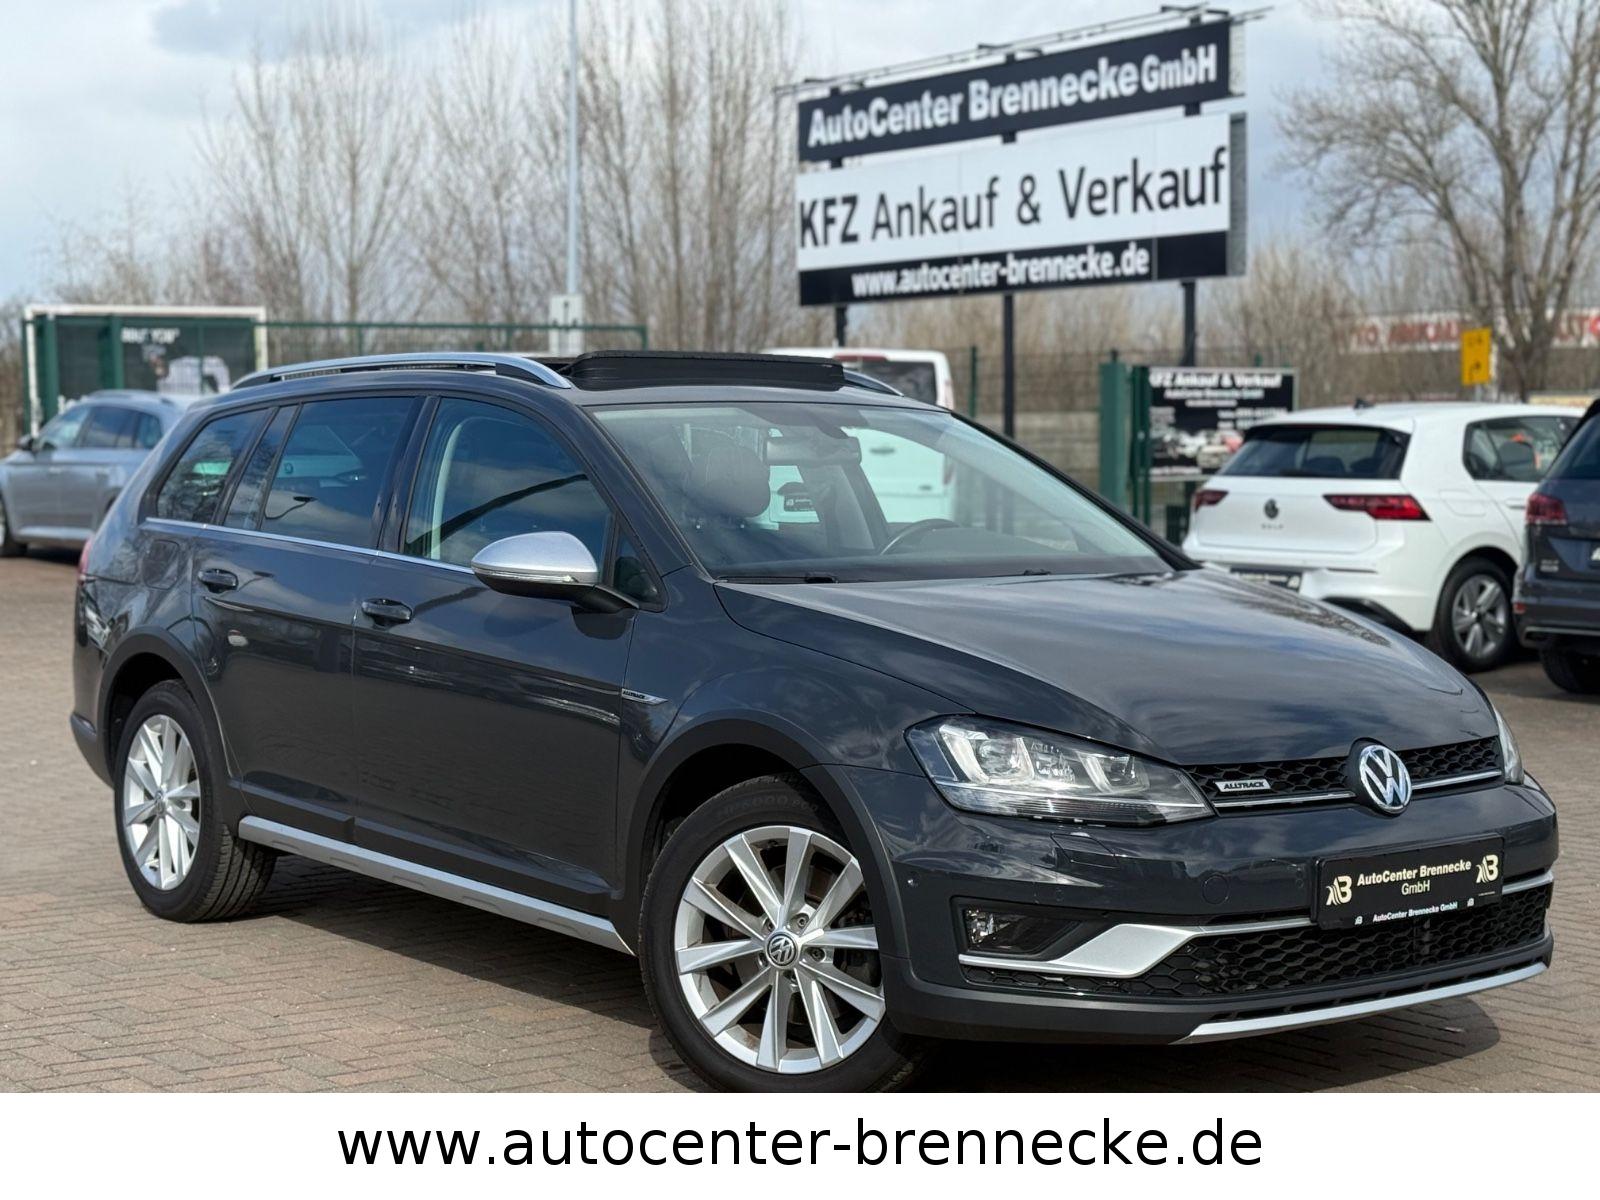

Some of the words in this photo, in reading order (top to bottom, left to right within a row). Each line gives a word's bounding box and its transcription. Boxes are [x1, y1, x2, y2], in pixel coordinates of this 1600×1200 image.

[808, 90, 964, 148] AutoCenter
[968, 57, 1139, 121] Brennecke
[1141, 44, 1217, 93] GmbH
[800, 194, 859, 249] KFZ
[871, 176, 1000, 241] Ankauf
[1017, 175, 1041, 227] &
[1058, 146, 1227, 220] Verkauf
[852, 241, 1150, 298] www.autocenter-brennecke.de
[1223, 781, 1265, 790] ALLTRACK
[1356, 868, 1418, 887] AutoCenter
[1419, 859, 1472, 878] Brennecke
[1401, 880, 1430, 896] GmbH
[1372, 911, 1408, 923] AutoCenter
[1408, 905, 1440, 917] Brennecke
[1440, 902, 1458, 912] GmbH
